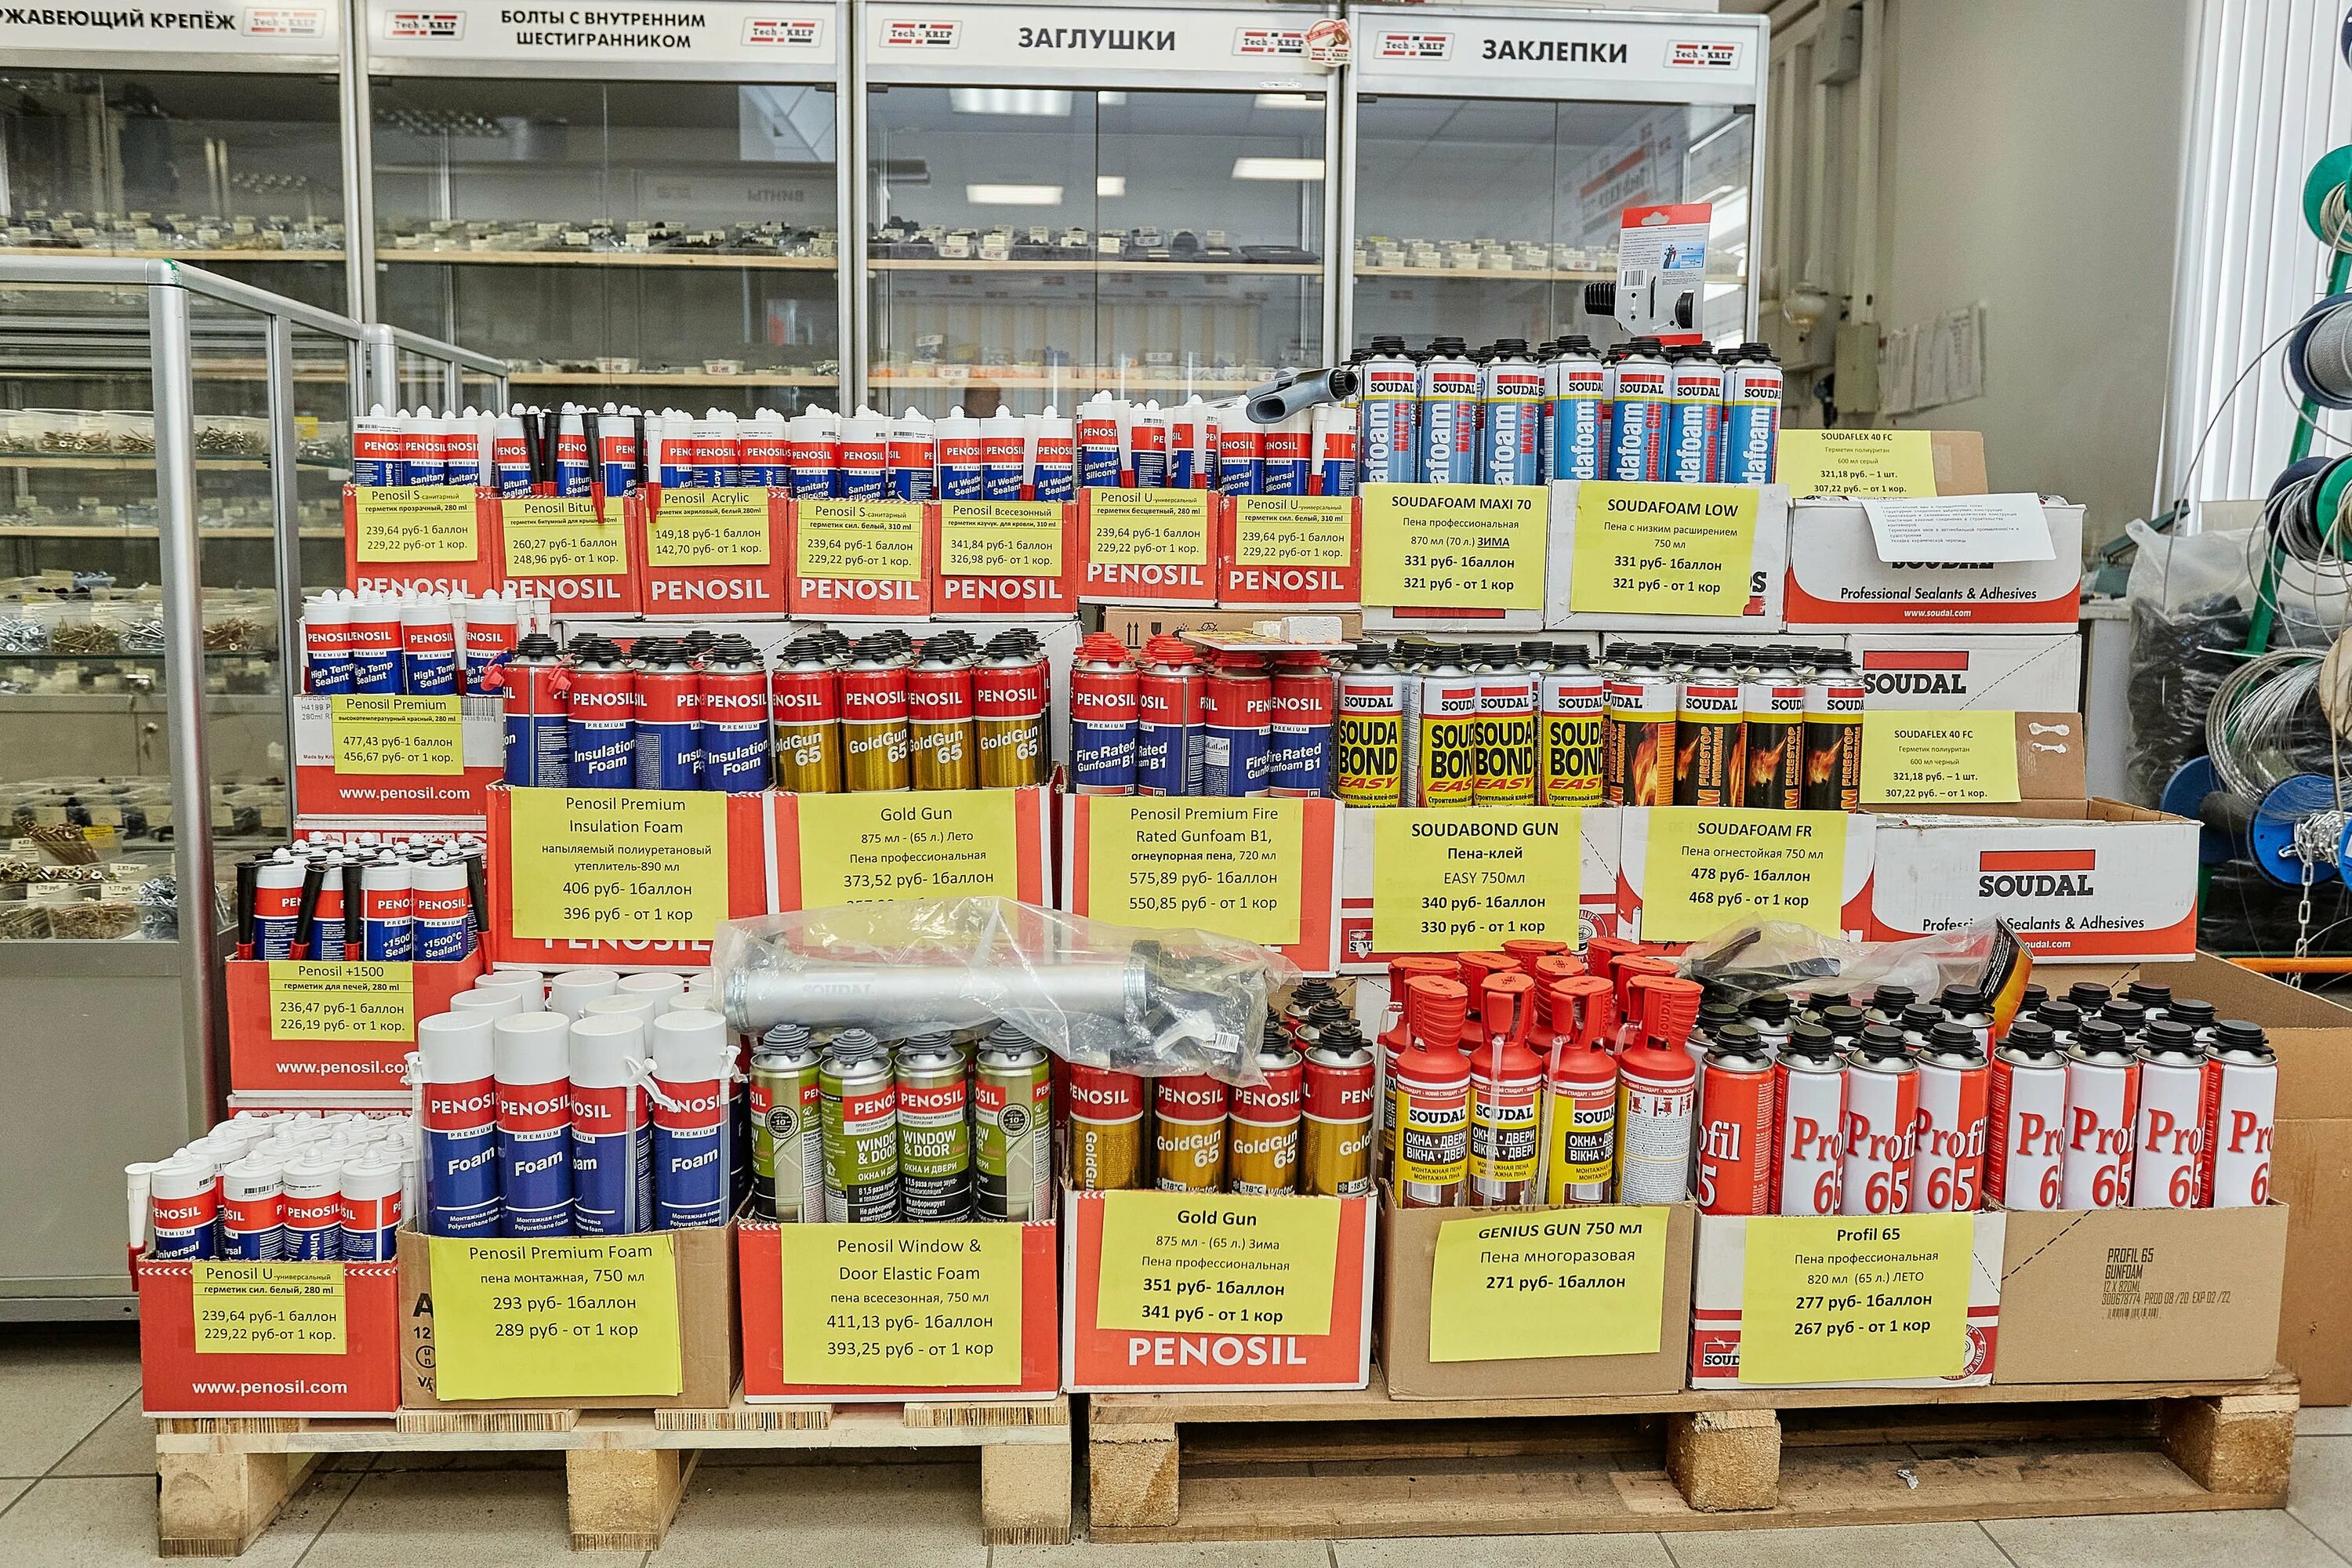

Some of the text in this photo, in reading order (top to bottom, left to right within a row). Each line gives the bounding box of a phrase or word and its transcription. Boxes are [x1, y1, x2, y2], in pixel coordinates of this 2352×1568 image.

[151, 10, 236, 30] КРЕПЁЖ
[502, 10, 705, 27] БОЛТЫ С ВНУТРЕННИМ
[517, 32, 691, 48] ШЕСТИГРАННИКОМ
[1018, 27, 1174, 50] ЗАГЛУШКИ
[1483, 39, 1627, 63] ЗАКЛЕПКИ
[1620, 384, 1663, 394] SOUDAL
[1084, 459, 1119, 471] Universal
[1086, 468, 1116, 480] Silicone
[504, 479, 528, 489] Bitum
[372, 490, 410, 500] Penosil
[503, 487, 532, 497] Sealant
[665, 492, 749, 504] Penosil Acrylic
[1248, 499, 1286, 509] Penosil
[1392, 496, 1531, 510] SOUDAFOAM MAXI 70
[1608, 499, 1738, 517] SOUDAFOAM LOW
[953, 506, 991, 515] Penosil
[1130, 507, 1174, 516] бесцветный,
[810, 521, 843, 530] герметик
[861, 522, 887, 531] белый,
[1605, 522, 1627, 531] Пена
[1674, 528, 1737, 536] расширением
[514, 555, 546, 565] 248,96
[550, 554, 572, 565] руб-
[589, 554, 593, 562] 1
[597, 555, 618, 564] кор.
[652, 580, 769, 601] PENOSIL
[1841, 587, 2036, 599] Professional Sealants & Adhesives
[1904, 609, 1971, 618] www.soudal.com
[311, 663, 354, 678] High Temp
[315, 673, 349, 687] Sealant
[1864, 673, 1966, 694] SOUDAL
[347, 699, 446, 710] Penosil Premium
[574, 694, 634, 706] PENOSIL
[850, 728, 906, 753] GoldGun
[1340, 722, 1397, 745] SOUDA
[887, 745, 907, 763] 65
[1077, 739, 1135, 761] Fire Rated
[1700, 726, 1711, 786] FIRESTOP
[1340, 747, 1397, 775] BOND
[1339, 776, 1399, 789] EASY
[340, 787, 470, 800] www.penosil.com
[881, 807, 952, 821] Gold Gun
[570, 819, 682, 833] Insulation Foam
[1412, 822, 1558, 837] SOUDABOND GUN
[1697, 822, 1811, 837] SOUDAFOAM FR
[1131, 853, 1203, 862] огнеупорная
[1240, 851, 1258, 859] 720
[1448, 847, 1522, 858] Пена-клей
[1682, 846, 1709, 856] Пена
[1714, 848, 1782, 858] огнестойкая
[1786, 849, 1805, 858] 750
[424, 931, 462, 948] +1500°C
[426, 942, 462, 958] Sealant
[1410, 1109, 1465, 1123] SOUDAL
[905, 1162, 956, 1174] ОКНА И ДВЕРИ
[1411, 1166, 1449, 1174] МОНТАЖНАЯ
[515, 1222, 553, 1231] Polyurethane
[1838, 1228, 1900, 1241] Profil 65
[470, 1246, 652, 1259] Penosil Premium Foam
[1481, 1251, 1635, 1264] Пена многоразовая
[2107, 1248, 2154, 1262] PROFIL 65
[207, 1268, 257, 1279] Penosil
[840, 1267, 979, 1279] Door Elastic Foam
[1808, 1275, 1828, 1284] 820
[1855, 1273, 1871, 1285] (65
[1875, 1272, 1889, 1283] л.)
[1893, 1272, 1923, 1282] ЛЕТО
[2105, 1265, 2143, 1279] GUNFOAM
[2103, 1280, 2140, 1294] 12 X 820ML
[2102, 1290, 2140, 1305] 300678774
[2144, 1293, 2162, 1305] PROD
[2164, 1291, 2173, 1304] 08
[2192, 1291, 2205, 1303] EXP
[2207, 1291, 2216, 1303] 02
[1129, 1337, 1306, 1366] PENOSIL
[192, 1381, 347, 1396] www.penosil.com
